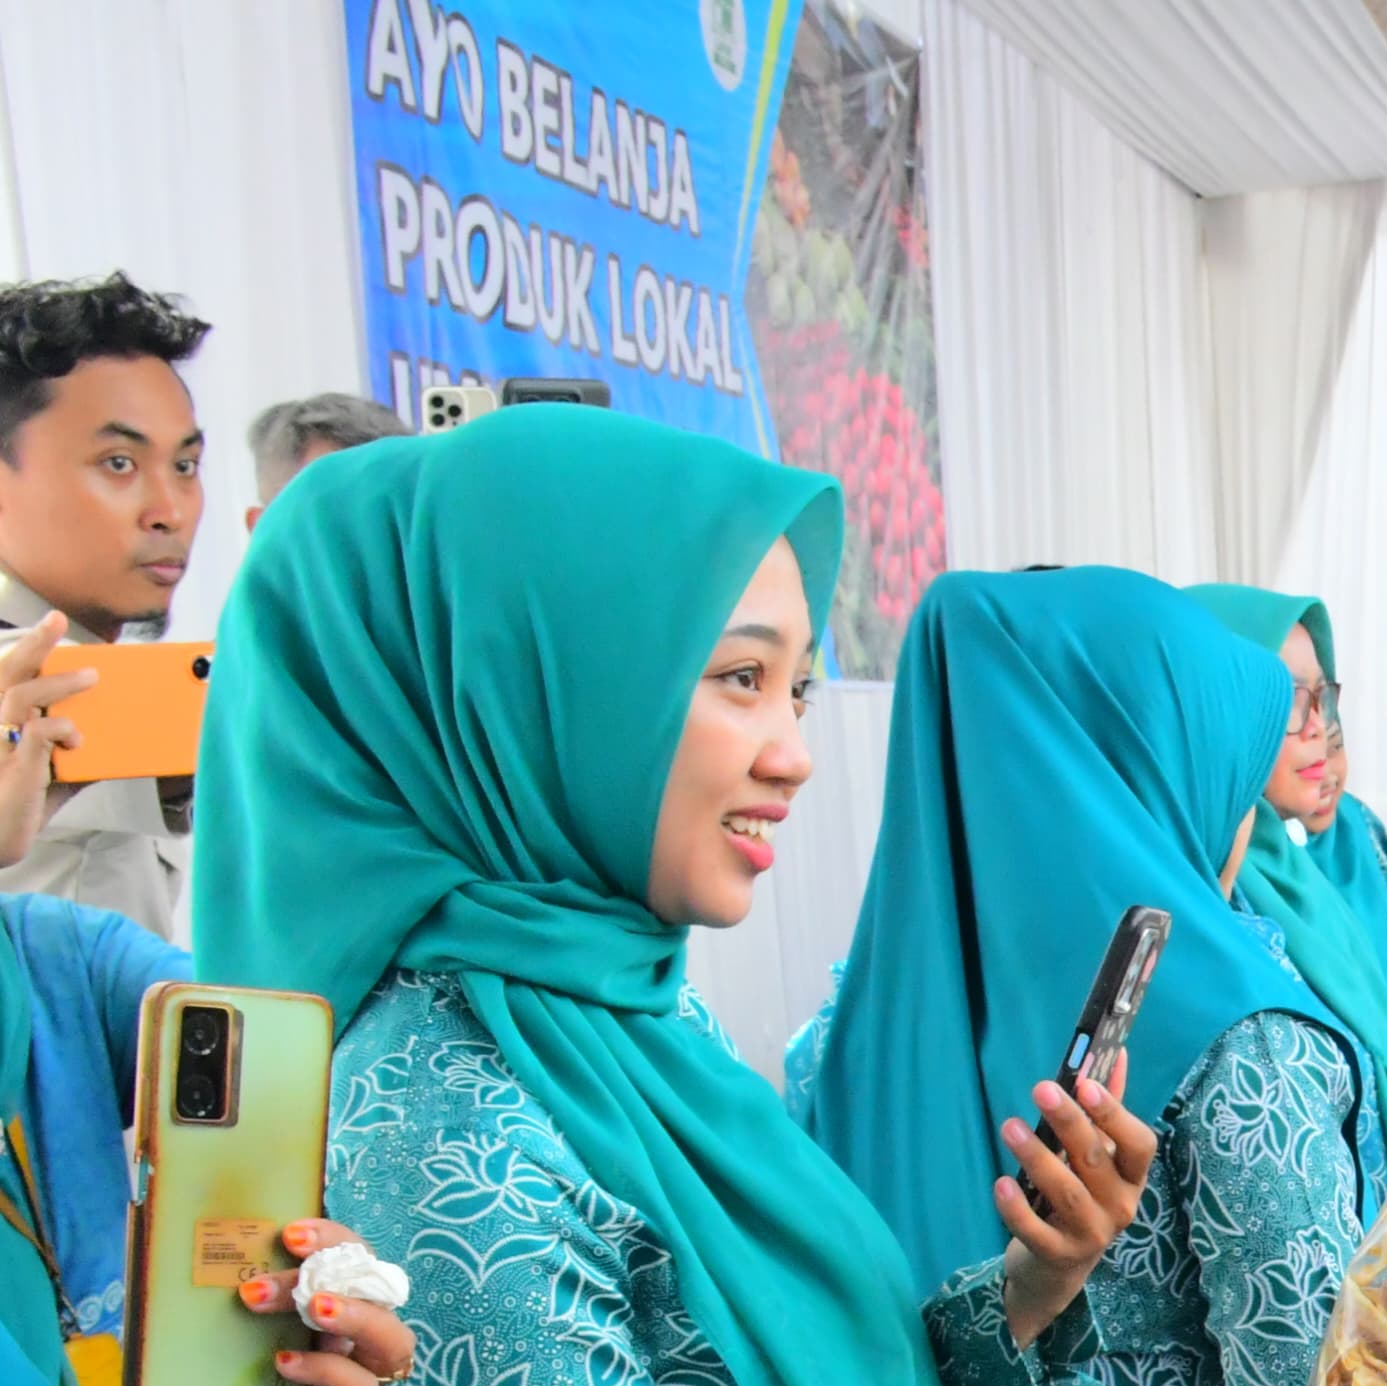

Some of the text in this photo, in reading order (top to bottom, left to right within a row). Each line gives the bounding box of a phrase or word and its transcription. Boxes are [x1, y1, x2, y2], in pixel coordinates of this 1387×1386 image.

[366, 0, 701, 238] AYO BELANJA
[376, 160, 601, 356] PRODUK
[607, 251, 745, 397] LOKAL
